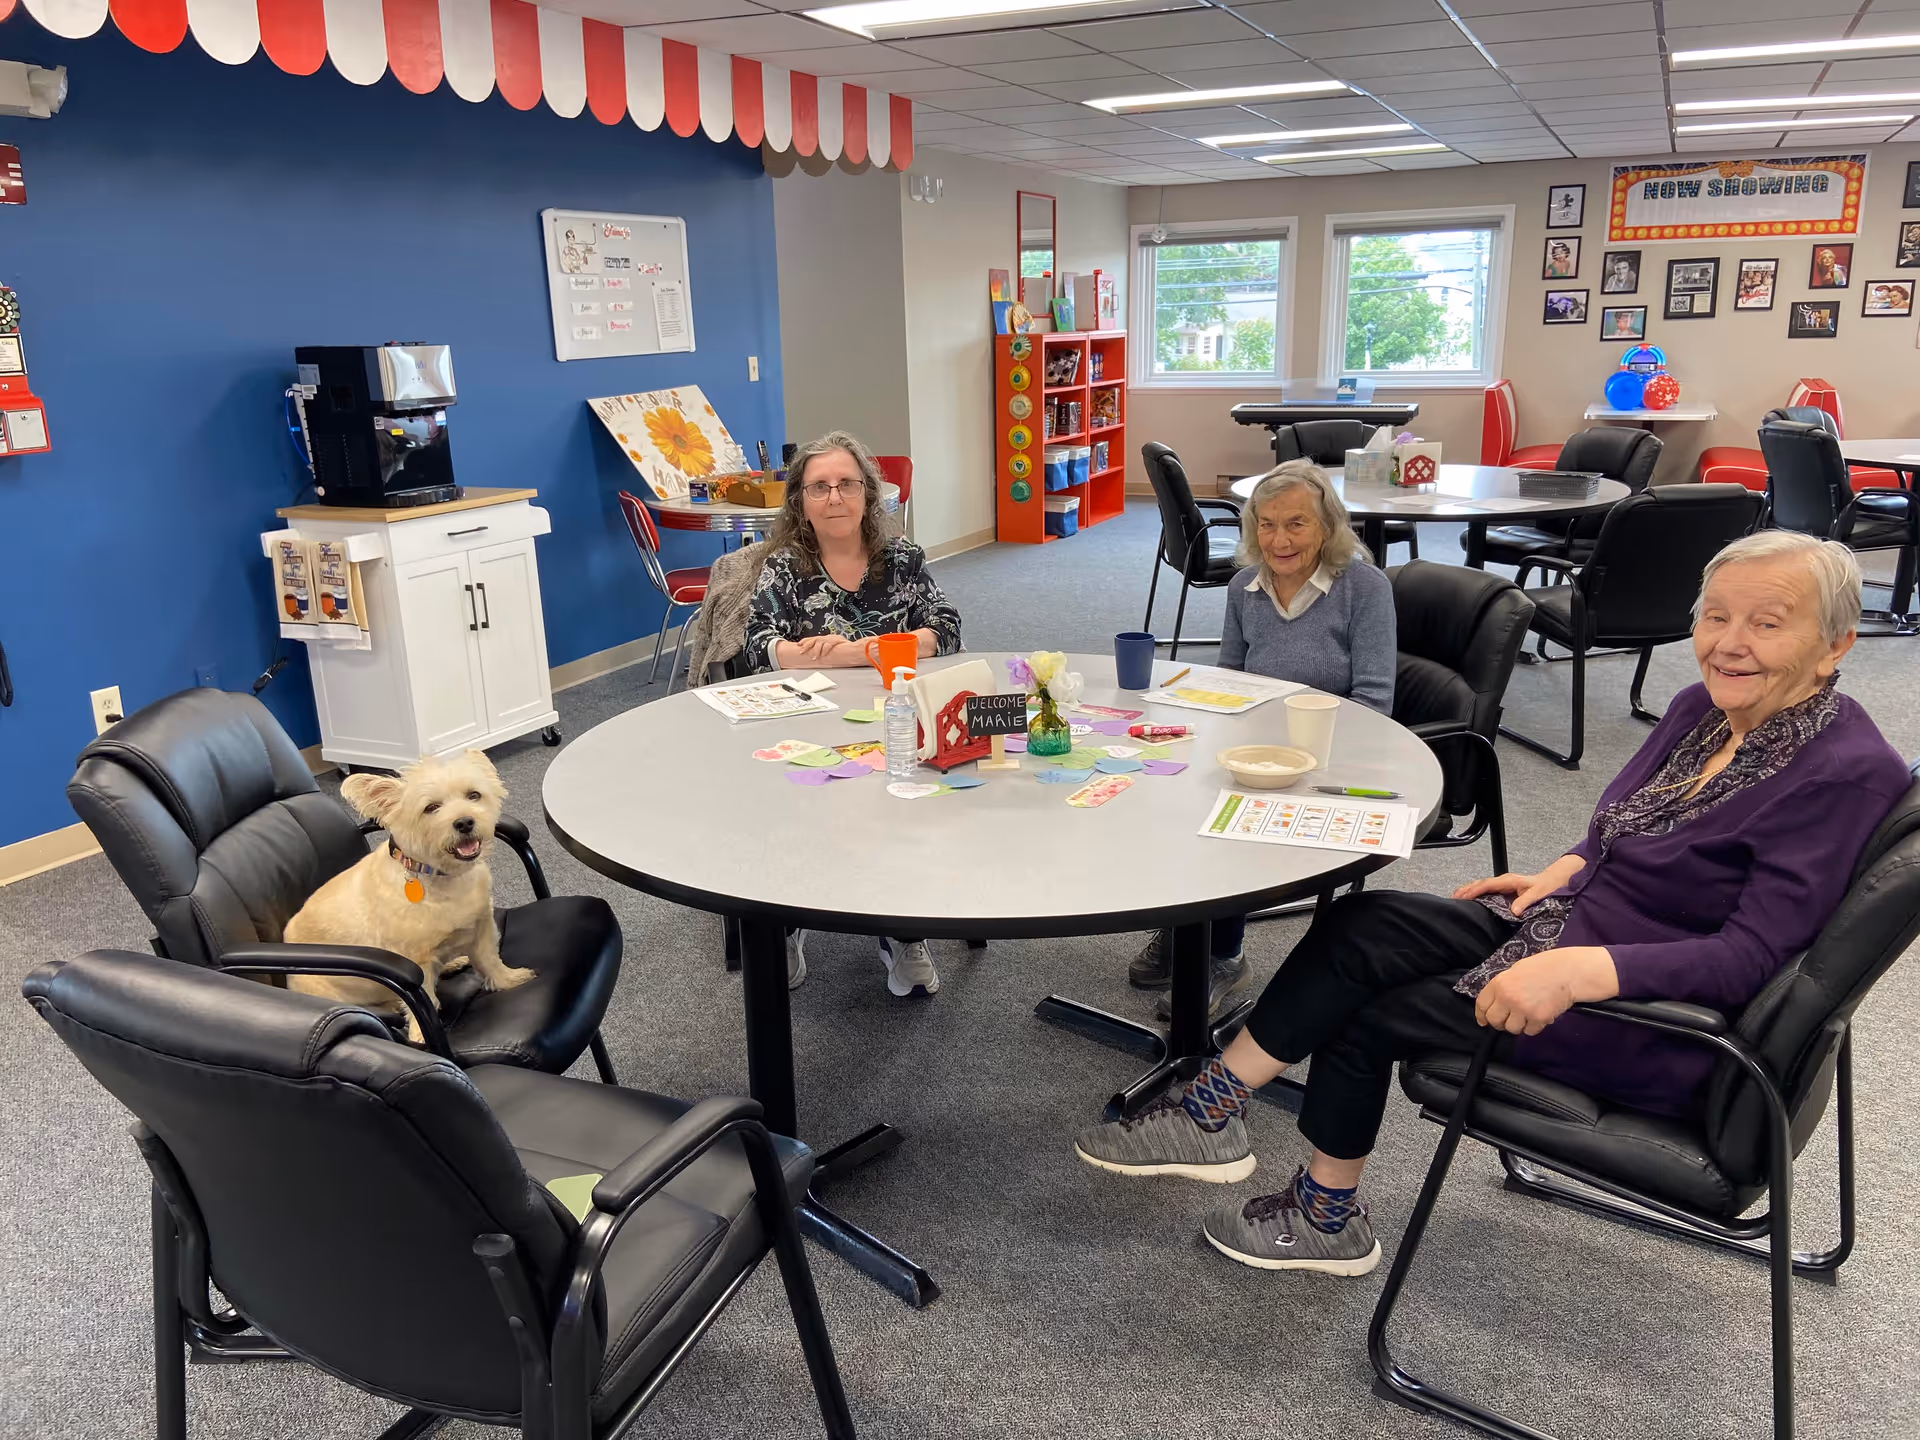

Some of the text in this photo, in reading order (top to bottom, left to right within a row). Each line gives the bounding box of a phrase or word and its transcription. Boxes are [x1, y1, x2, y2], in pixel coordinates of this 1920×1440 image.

[1643, 173, 1830, 200] NOW SHOWING
[967, 695, 1026, 711] WELCOME
